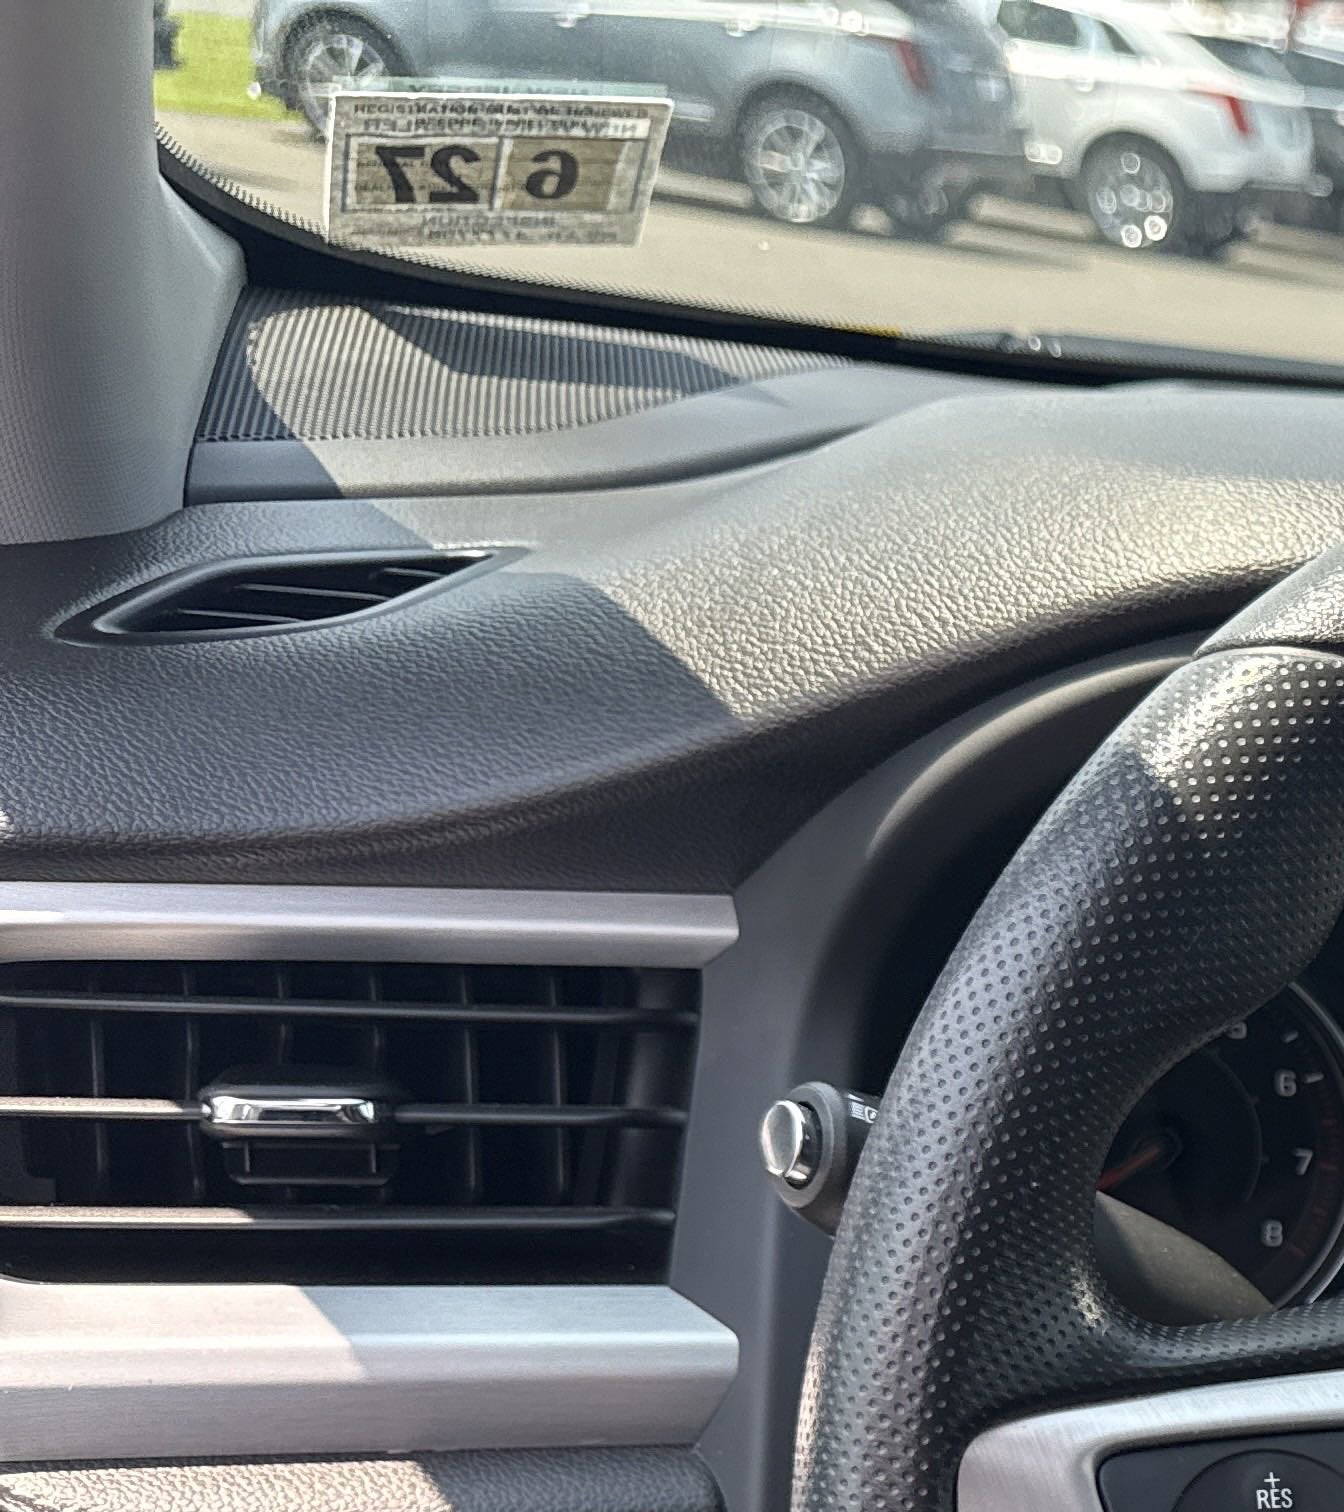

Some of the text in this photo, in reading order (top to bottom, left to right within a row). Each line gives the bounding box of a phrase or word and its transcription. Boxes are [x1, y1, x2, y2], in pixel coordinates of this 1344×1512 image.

[1276, 1069, 1297, 1096] 6
[1295, 1149, 1313, 1176] 7
[1261, 1218, 1284, 1247] 8
[1256, 1487, 1294, 1510] RES
